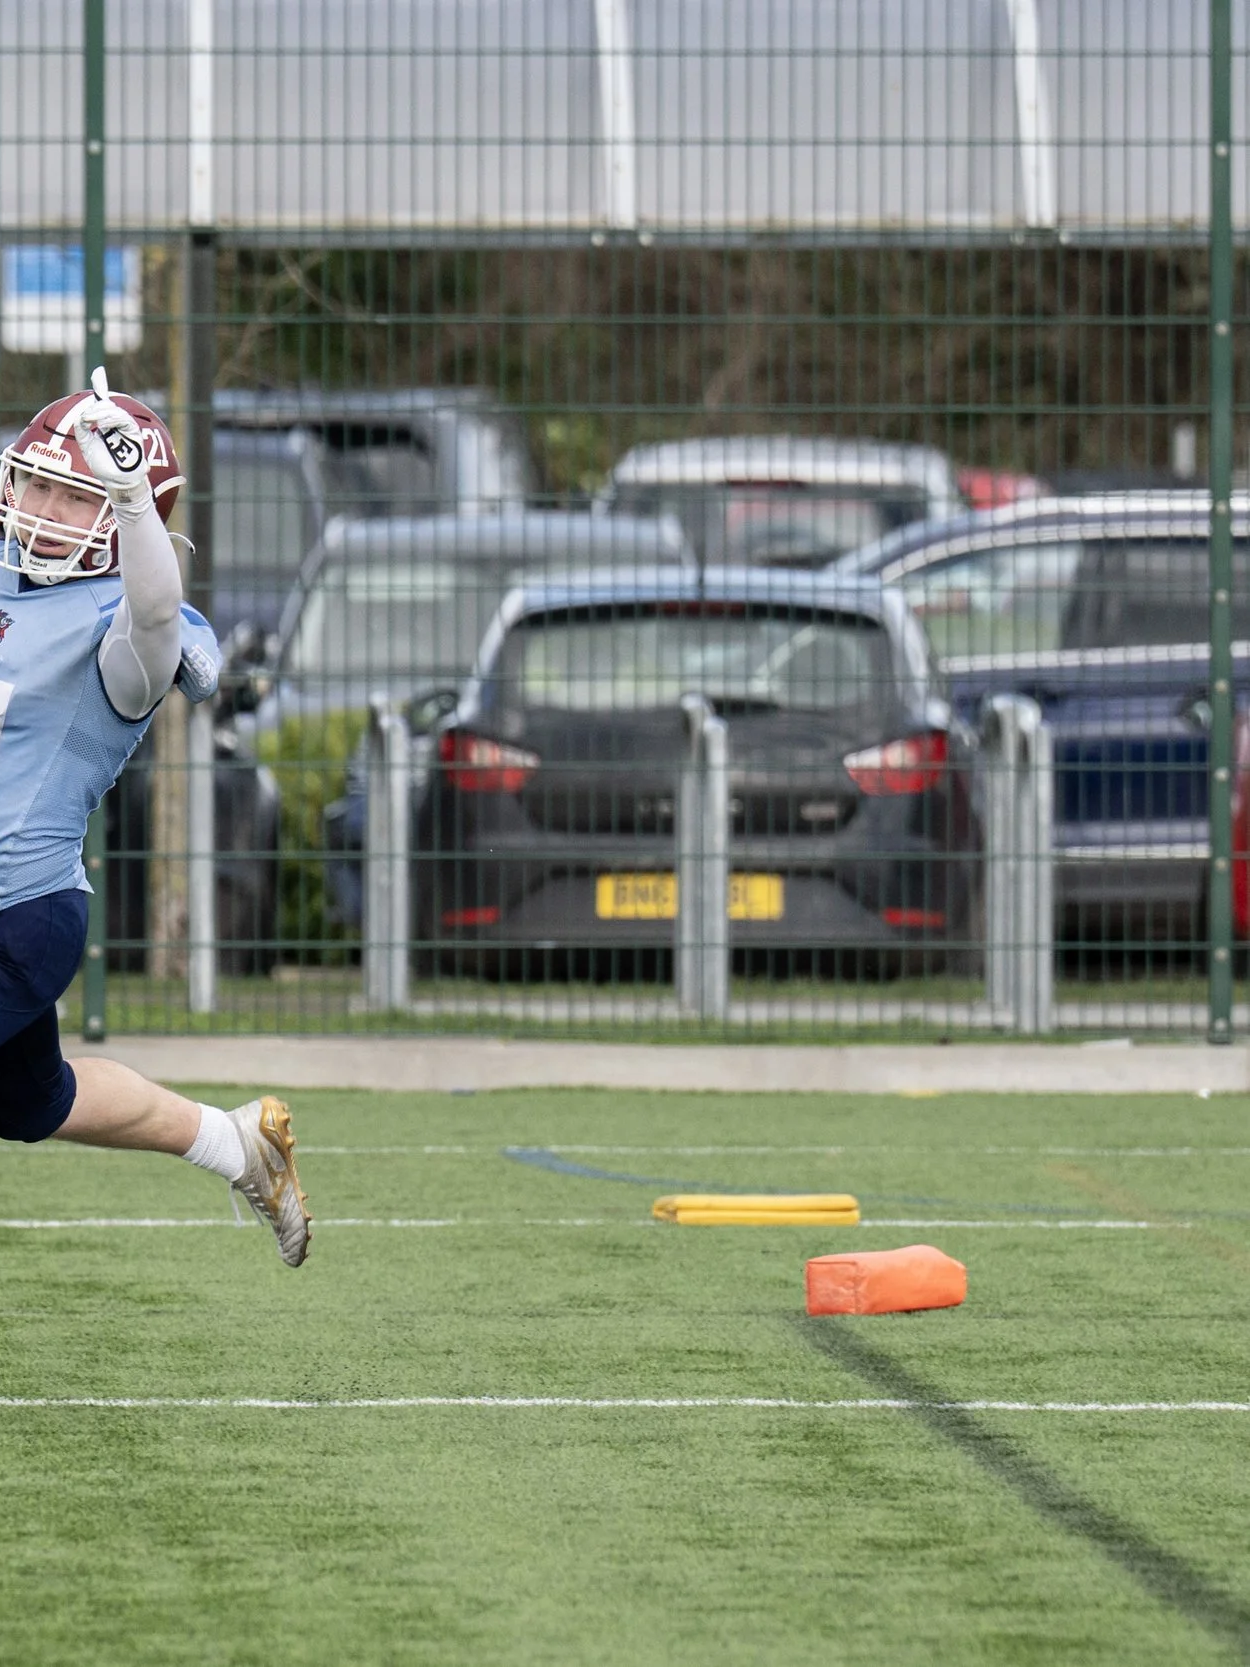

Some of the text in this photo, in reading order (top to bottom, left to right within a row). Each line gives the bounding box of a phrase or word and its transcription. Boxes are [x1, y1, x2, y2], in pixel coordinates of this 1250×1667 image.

[30, 443, 66, 462] Riddell
[142, 428, 169, 467] 21
[4, 480, 17, 509] Ridde
